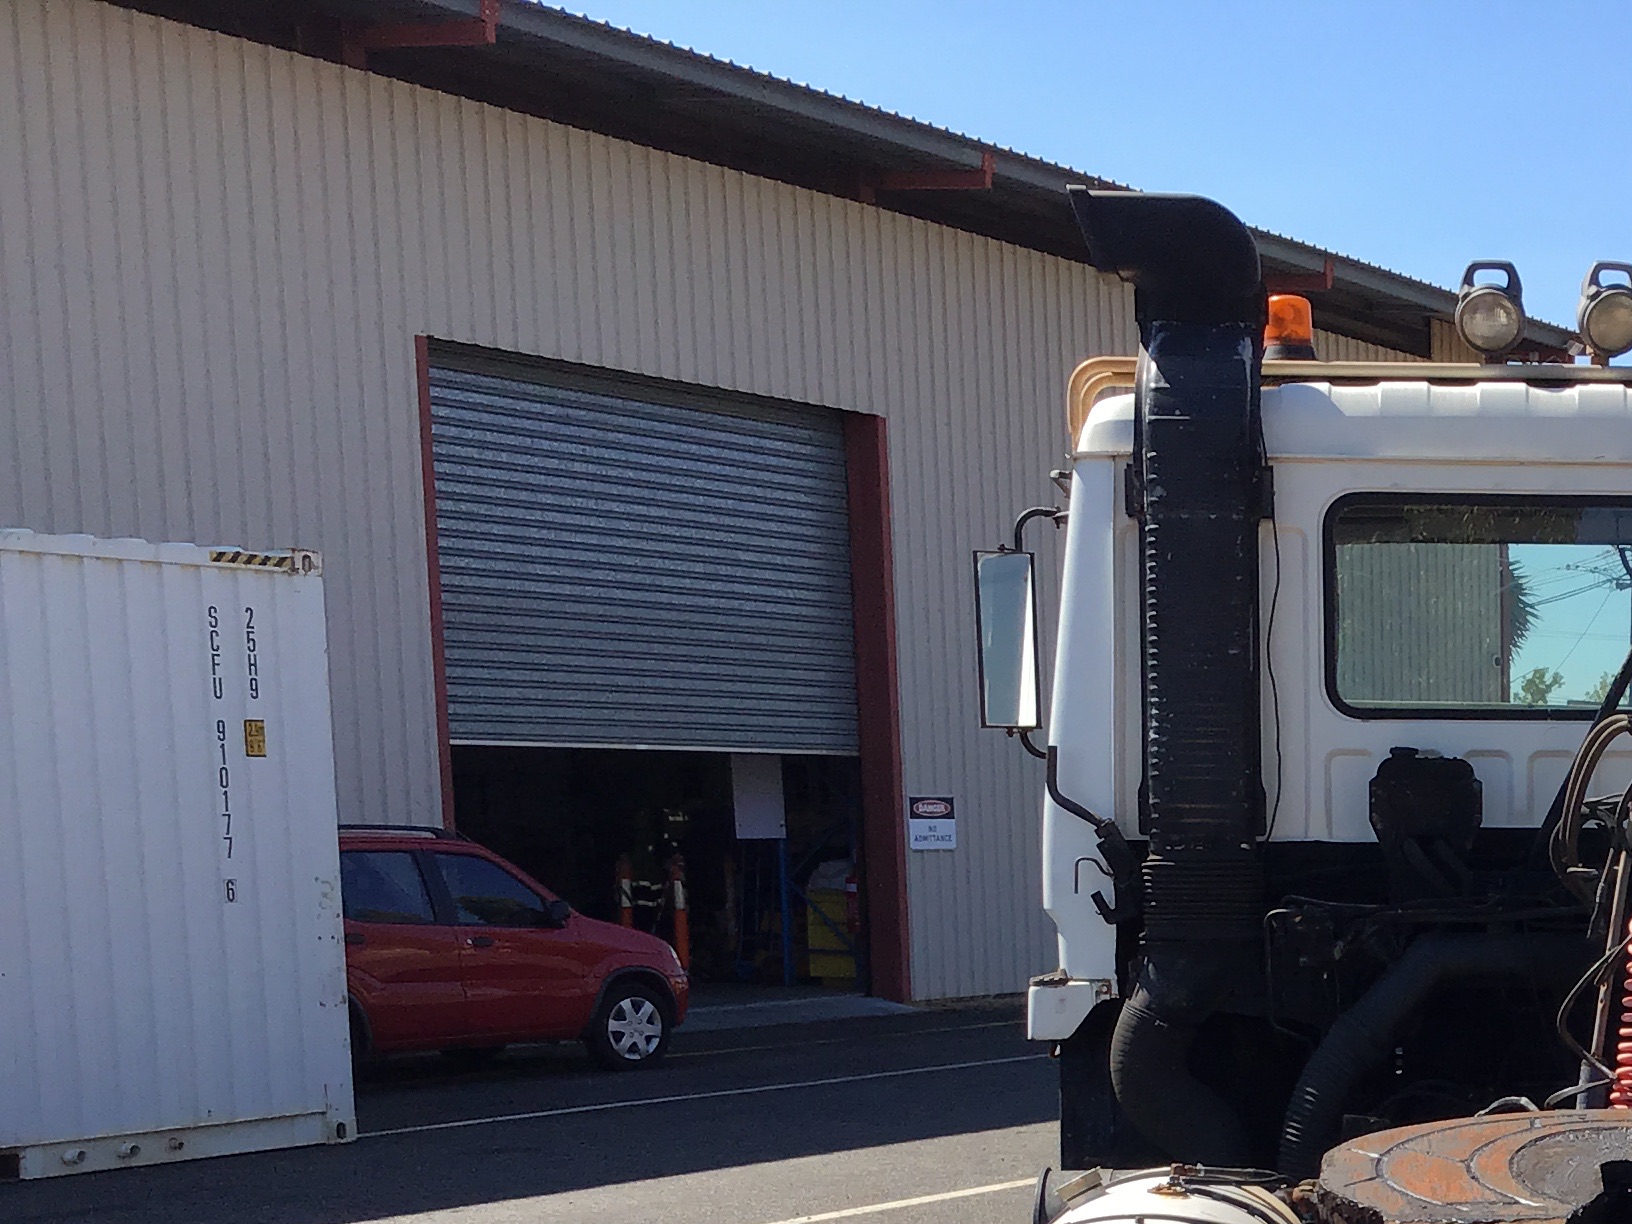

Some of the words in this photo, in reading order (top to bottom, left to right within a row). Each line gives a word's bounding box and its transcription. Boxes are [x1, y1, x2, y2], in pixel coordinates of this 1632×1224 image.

[245, 607, 259, 699] 25H9
[208, 606, 223, 699] SCFU
[217, 720, 232, 858] 910177
[226, 879, 235, 902] 6
